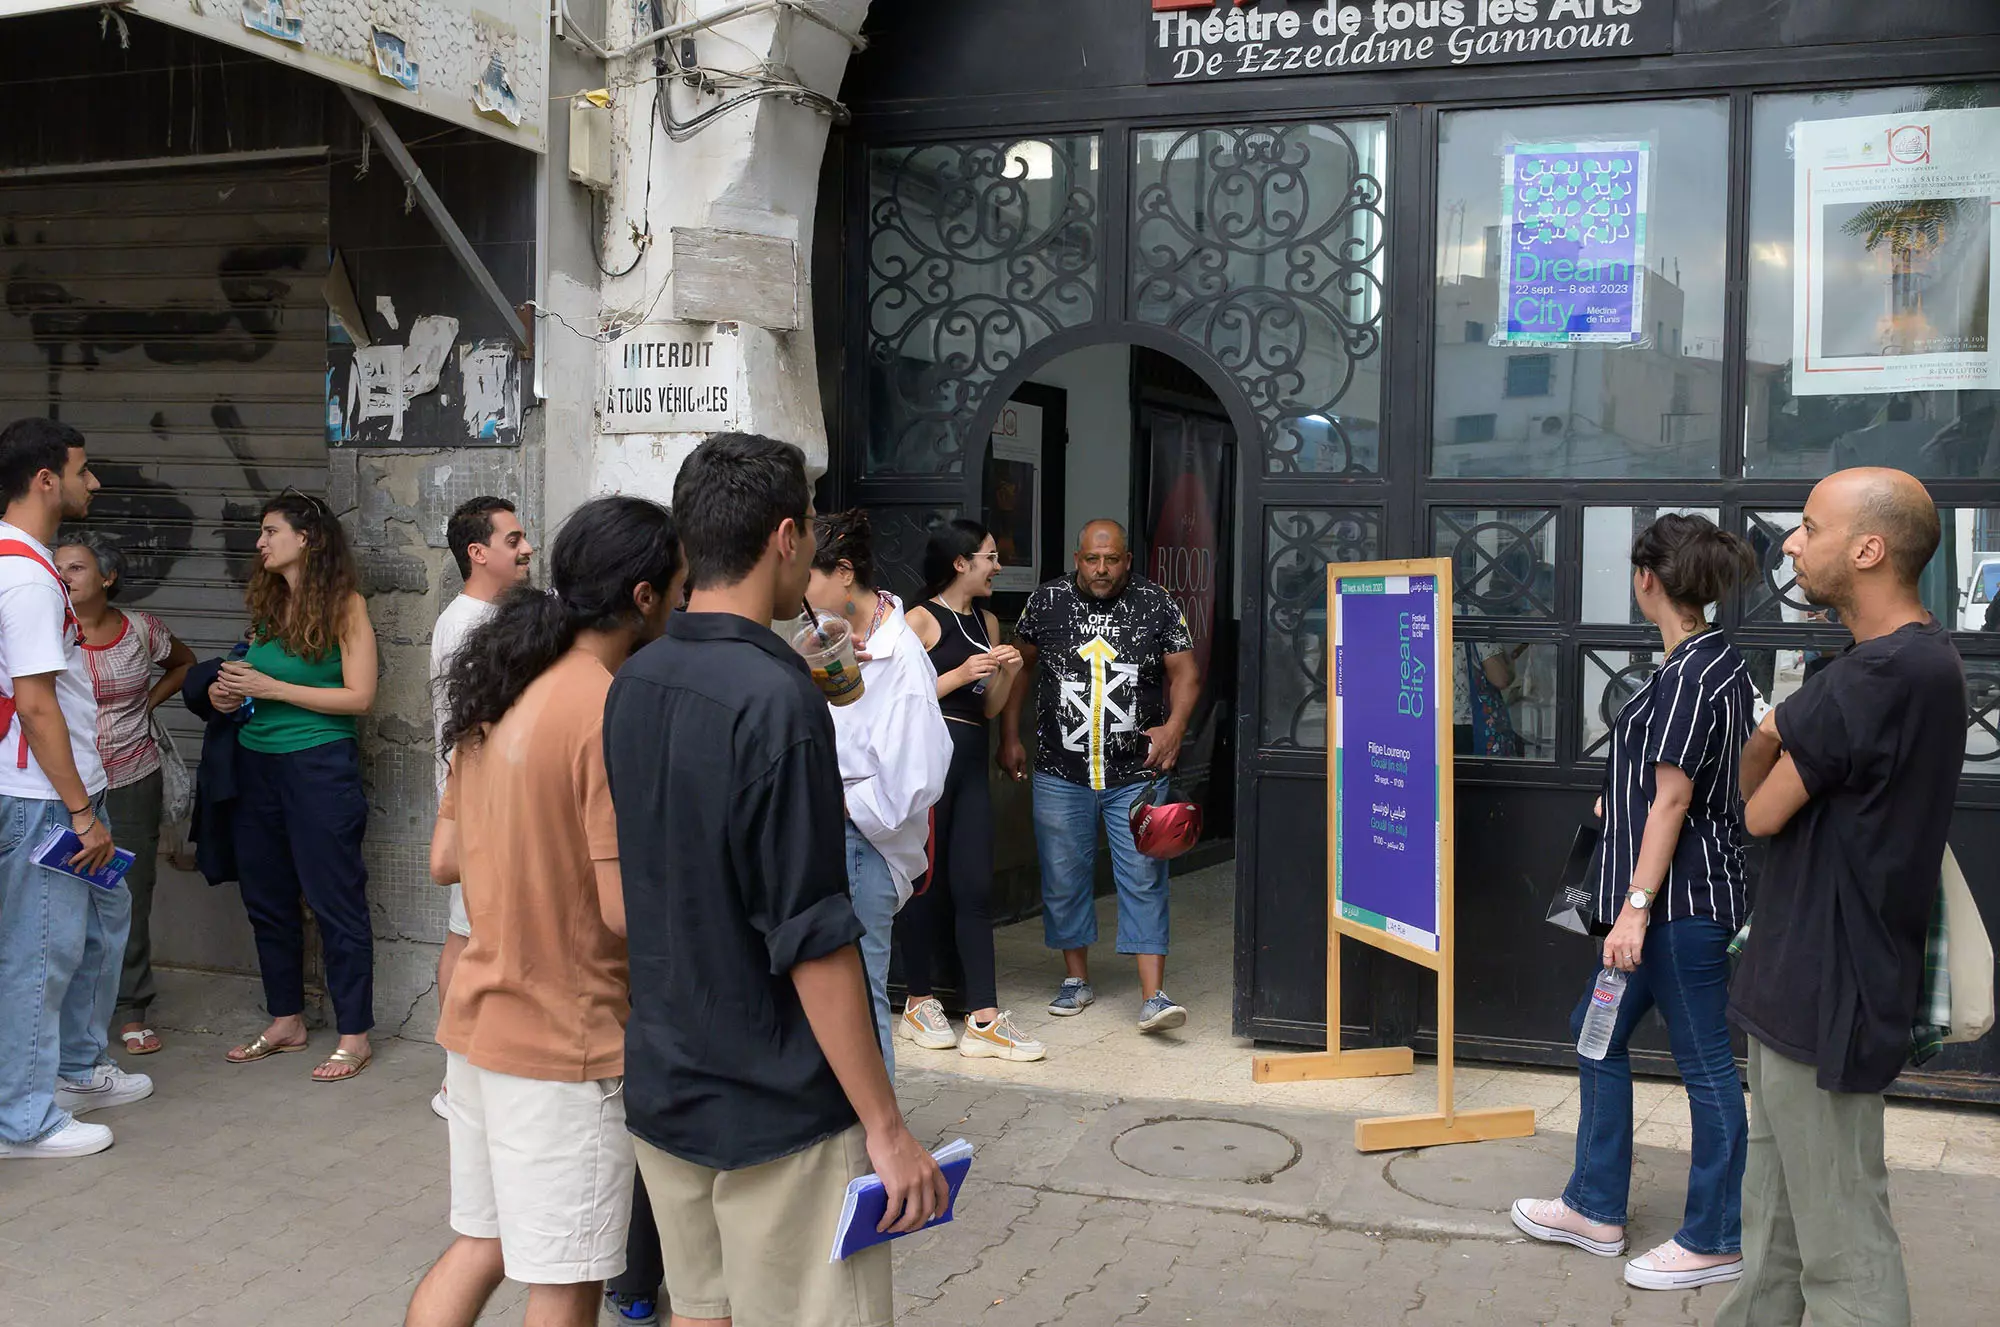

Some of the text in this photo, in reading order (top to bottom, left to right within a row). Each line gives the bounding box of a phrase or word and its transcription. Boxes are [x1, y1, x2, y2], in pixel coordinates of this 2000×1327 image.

[1152, 7, 1300, 48] Théâtre
[1312, 0, 1362, 36] de
[1372, 0, 1465, 34] tous
[1477, 0, 1539, 26] les
[1173, 23, 1634, 79] De Ezzeddine Gannoun
[1514, 252, 1629, 282] Dream
[1515, 285, 1529, 295] 22
[1531, 285, 1556, 297] sept.
[1569, 284, 1577, 294] 8
[1578, 284, 1598, 294] oct.
[1600, 283, 1629, 294] 2023
[1513, 296, 1575, 331] City
[1586, 306, 1618, 315] Médina
[1586, 315, 1621, 324] de Tunis
[618, 387, 652, 413] TOUS
[1158, 546, 1211, 592] BLOOD
[1080, 624, 1121, 637] WHITE
[1398, 611, 1411, 715] Dream
[1411, 656, 1426, 719] City
[1368, 741, 1411, 761] Filipe Lourenço
